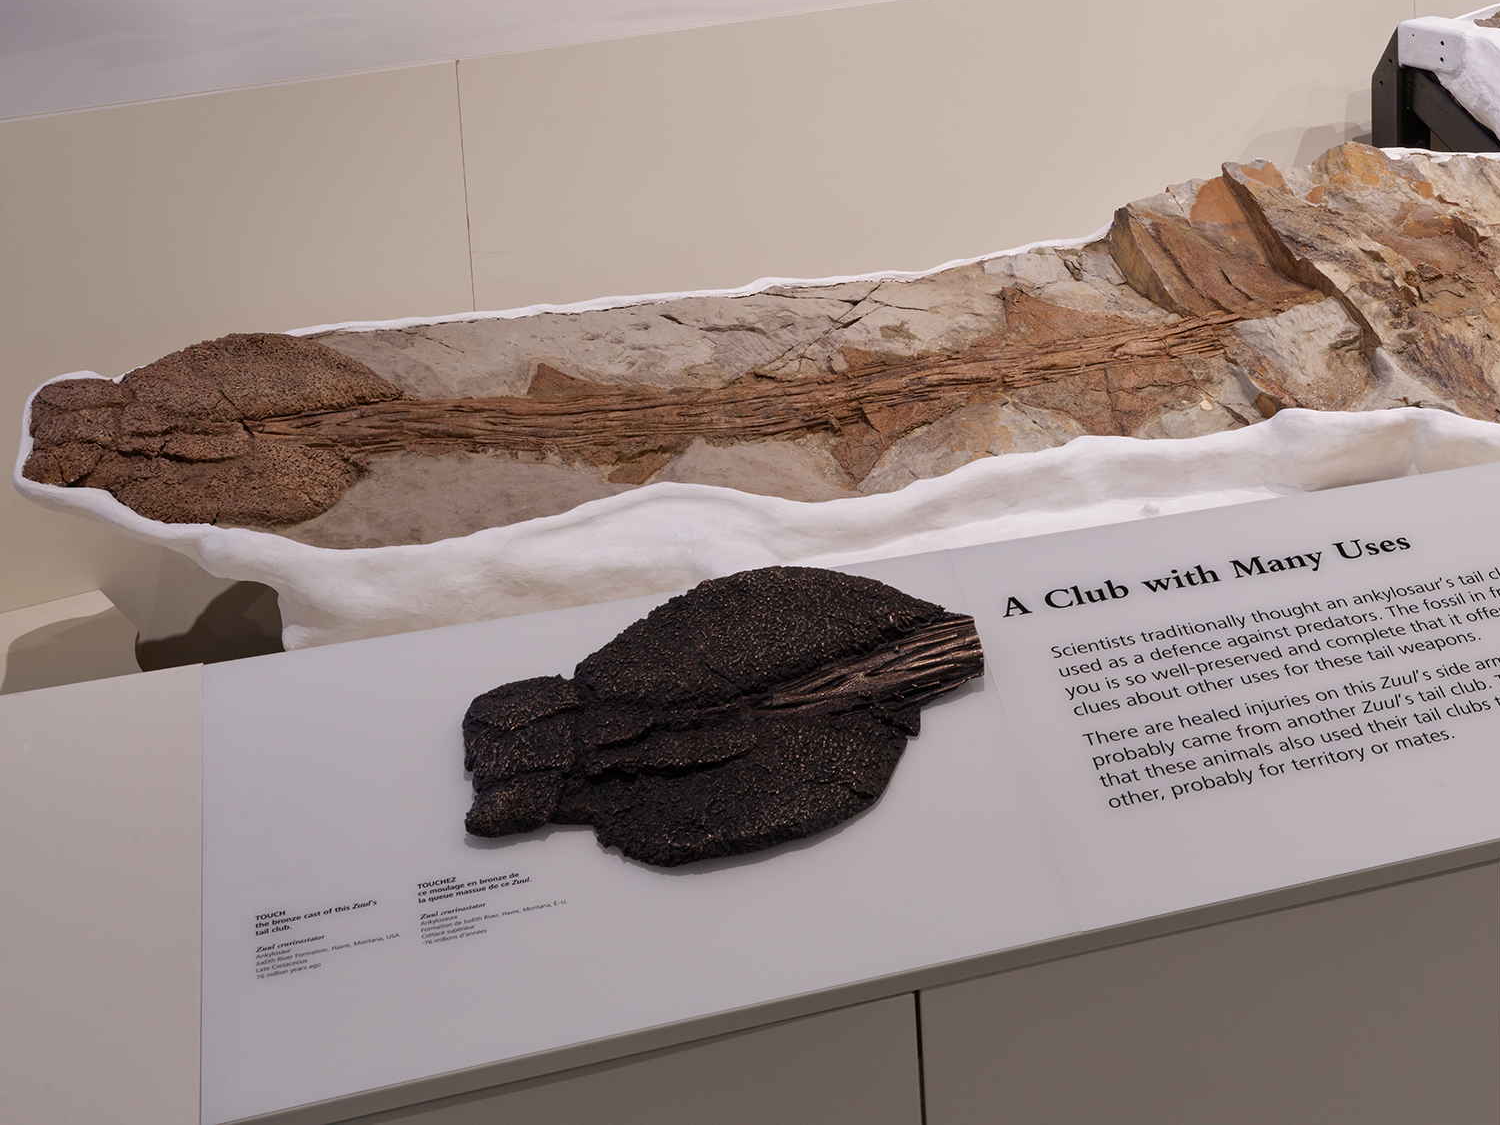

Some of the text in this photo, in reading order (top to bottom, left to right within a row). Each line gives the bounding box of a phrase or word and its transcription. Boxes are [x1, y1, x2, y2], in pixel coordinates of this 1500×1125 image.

[1003, 537, 1411, 618] A Club with Many Uses
[1051, 636, 1136, 658] Scientists
[1140, 615, 1245, 642] traditionally
[1250, 601, 1322, 623] thought
[1326, 599, 1348, 609] an
[1353, 577, 1454, 605] ankylosaur's
[1457, 570, 1484, 585] tail
[1059, 658, 1102, 677] used
[1109, 657, 1128, 668] as
[1134, 654, 1144, 664] a
[1150, 640, 1222, 661] defence
[1227, 626, 1291, 648] against
[1295, 612, 1382, 638] predators.
[1385, 604, 1420, 617] The
[1423, 593, 1466, 611] fossil
[1468, 591, 1486, 602] in
[1065, 682, 1100, 700] you
[1105, 677, 1120, 689] is
[1126, 674, 1146, 686] so
[1151, 646, 1283, 680] well-preserved
[1288, 639, 1321, 656] and
[1326, 626, 1406, 648] complete
[1409, 617, 1446, 632] that
[1448, 614, 1463, 625] it
[1074, 632, 1481, 716] clues about other uses for these tail weapons.
[1082, 728, 1139, 746] There
[1145, 721, 1174, 735] are
[1178, 705, 1241, 728] healed
[1245, 695, 1310, 716] injuries
[1316, 689, 1339, 701] on
[1343, 681, 1376, 696] this
[1380, 669, 1432, 689] Zuul's
[1436, 662, 1471, 678] side
[1092, 740, 1174, 770] probably
[1182, 731, 1232, 749] came
[1236, 722, 1281, 738] from
[1287, 706, 1355, 728] another
[1362, 693, 1414, 714] Zuul's
[1417, 686, 1446, 702] tail
[1451, 679, 1492, 695] club.
[1099, 769, 1141, 787] that
[1144, 760, 1197, 778] these
[1203, 743, 1273, 767] animals
[1279, 737, 1315, 752] also
[1320, 723, 1363, 743] used
[1367, 716, 1407, 733] their
[1413, 707, 1442, 724] tail
[1446, 700, 1491, 717] clubs
[1109, 730, 1455, 808] other, probably for territory or mates.
[255, 910, 286, 921] TOUCH
[272, 915, 302, 925] bronze
[303, 911, 321, 919] cast
[334, 905, 350, 913] this
[352, 900, 377, 910] Zuul's
[417, 876, 457, 889] TOUCHEZ
[428, 893, 454, 903] queue
[456, 886, 486, 896] massue
[511, 876, 532, 886] Zuul.
[429, 883, 465, 894] moulage
[479, 875, 507, 885] bronze
[255, 924, 292, 936] tail club.
